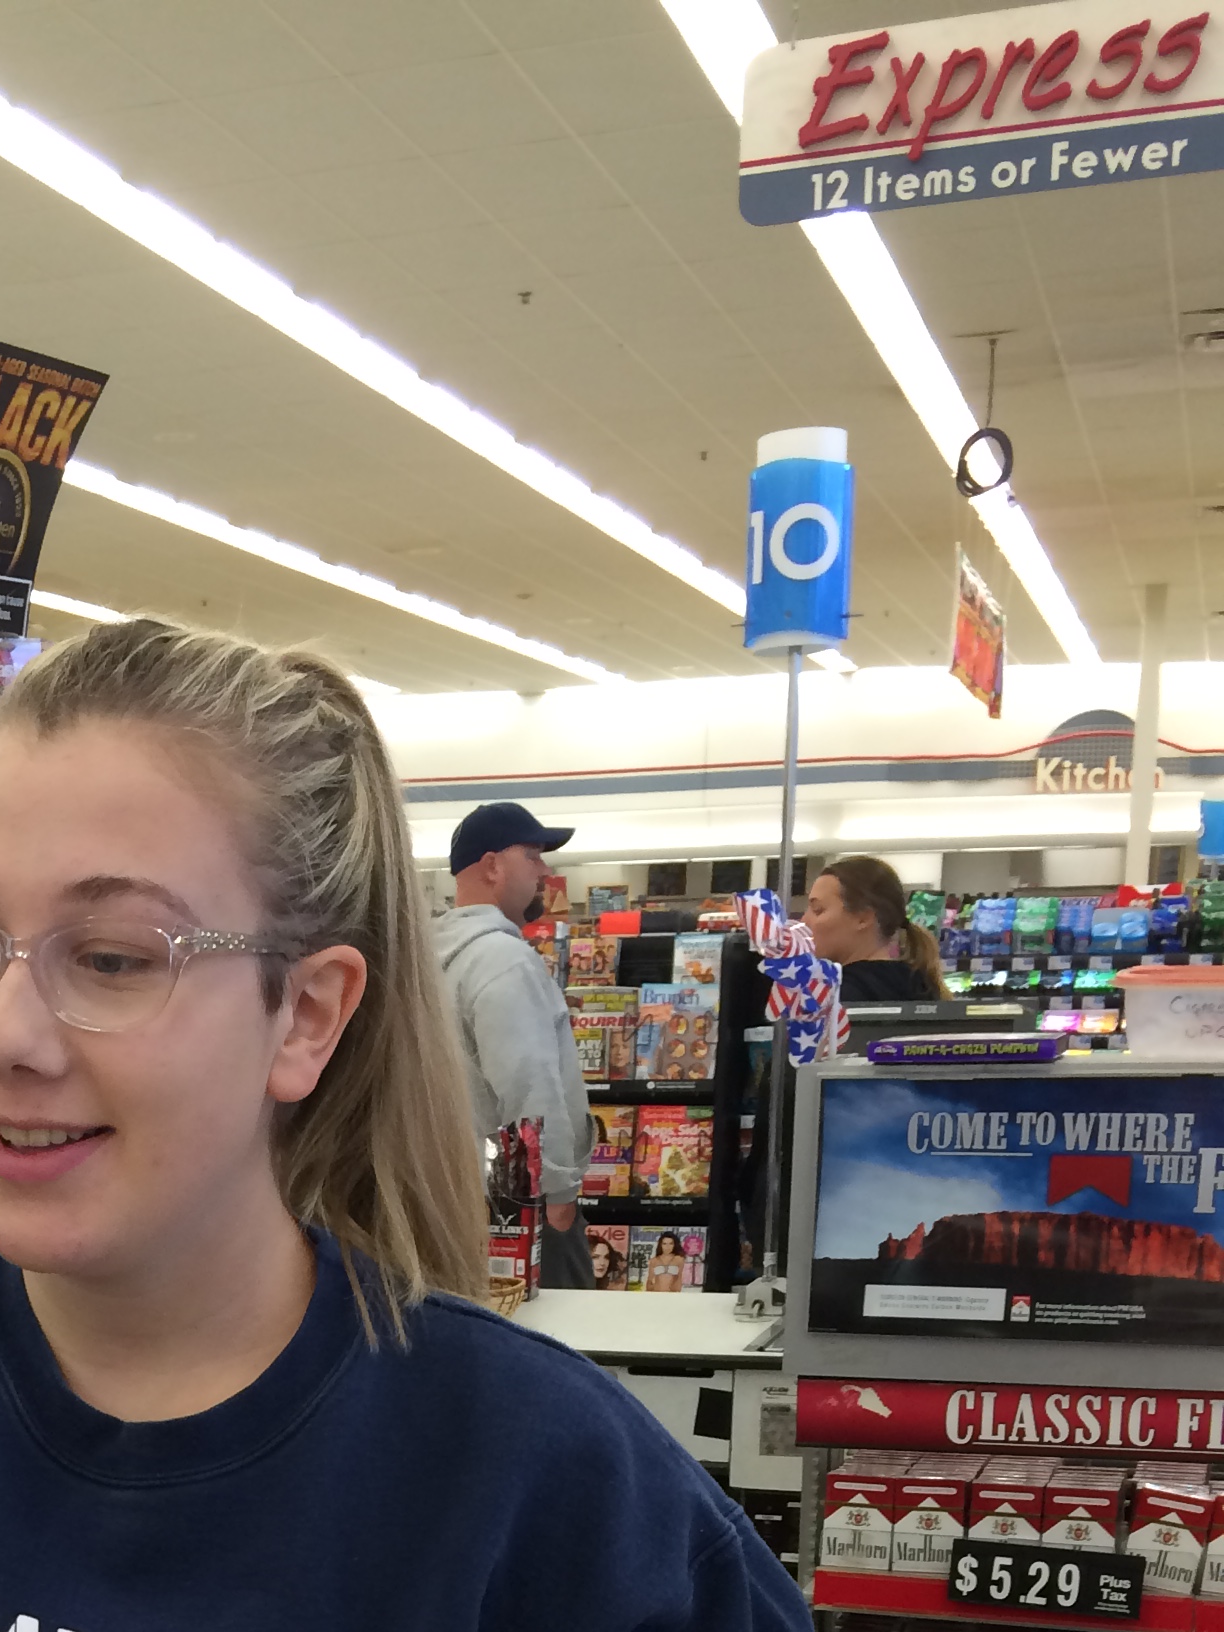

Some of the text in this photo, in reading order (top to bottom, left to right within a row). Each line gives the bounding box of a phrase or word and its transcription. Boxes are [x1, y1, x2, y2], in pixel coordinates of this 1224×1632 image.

[798, 12, 1210, 162] Express
[811, 136, 1188, 211] 12 Items or Fewer
[749, 502, 840, 585] 10
[1036, 756, 1164, 792] Kitchn
[907, 1110, 1196, 1154] COME TO WHERE
[1143, 1154, 1197, 1185] THE
[945, 1389, 1157, 1447] CLASSIC
[826, 1534, 887, 1561] Marlboro
[896, 1534, 952, 1563] Marlbor
[1099, 1574, 1131, 1589] Plus
[1100, 1589, 1127, 1602] Tax
